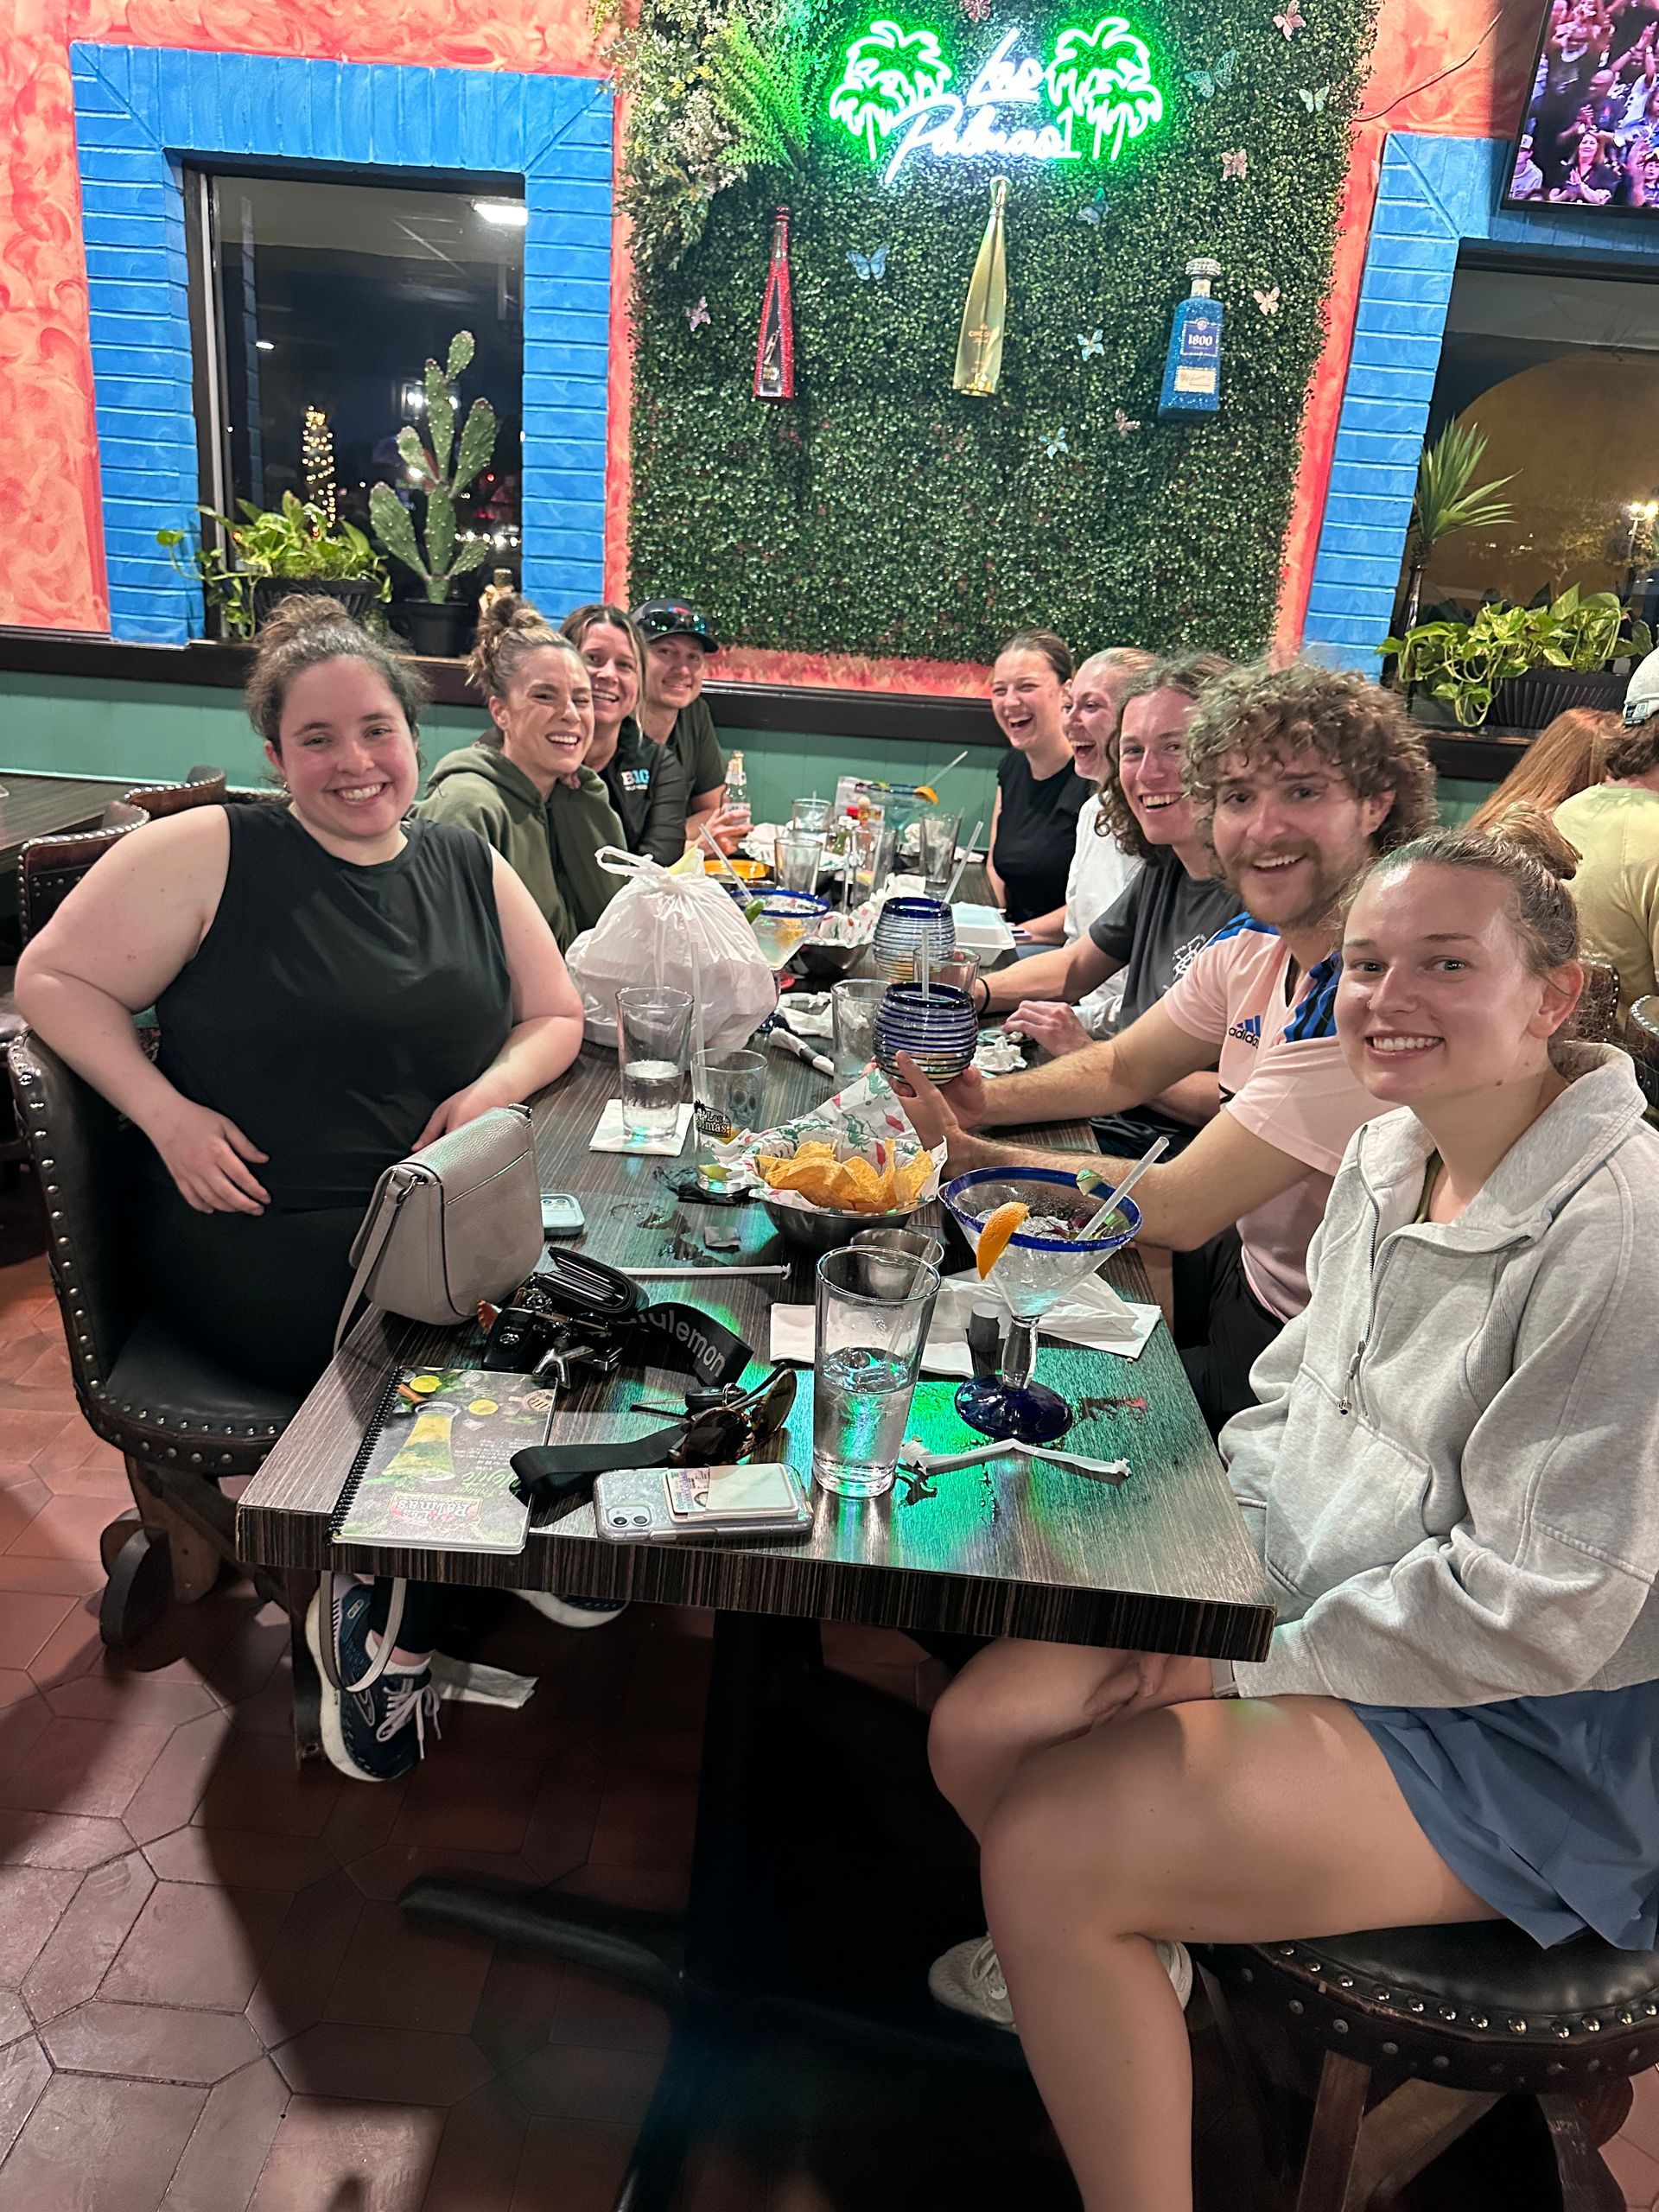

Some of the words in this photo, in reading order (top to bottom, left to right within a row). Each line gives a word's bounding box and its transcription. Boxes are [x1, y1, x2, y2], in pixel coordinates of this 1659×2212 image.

[966, 27, 1044, 105] Las
[883, 92, 1068, 184] Palmas
[1188, 334, 1213, 346] 1800
[706, 1111, 723, 1123] Las
